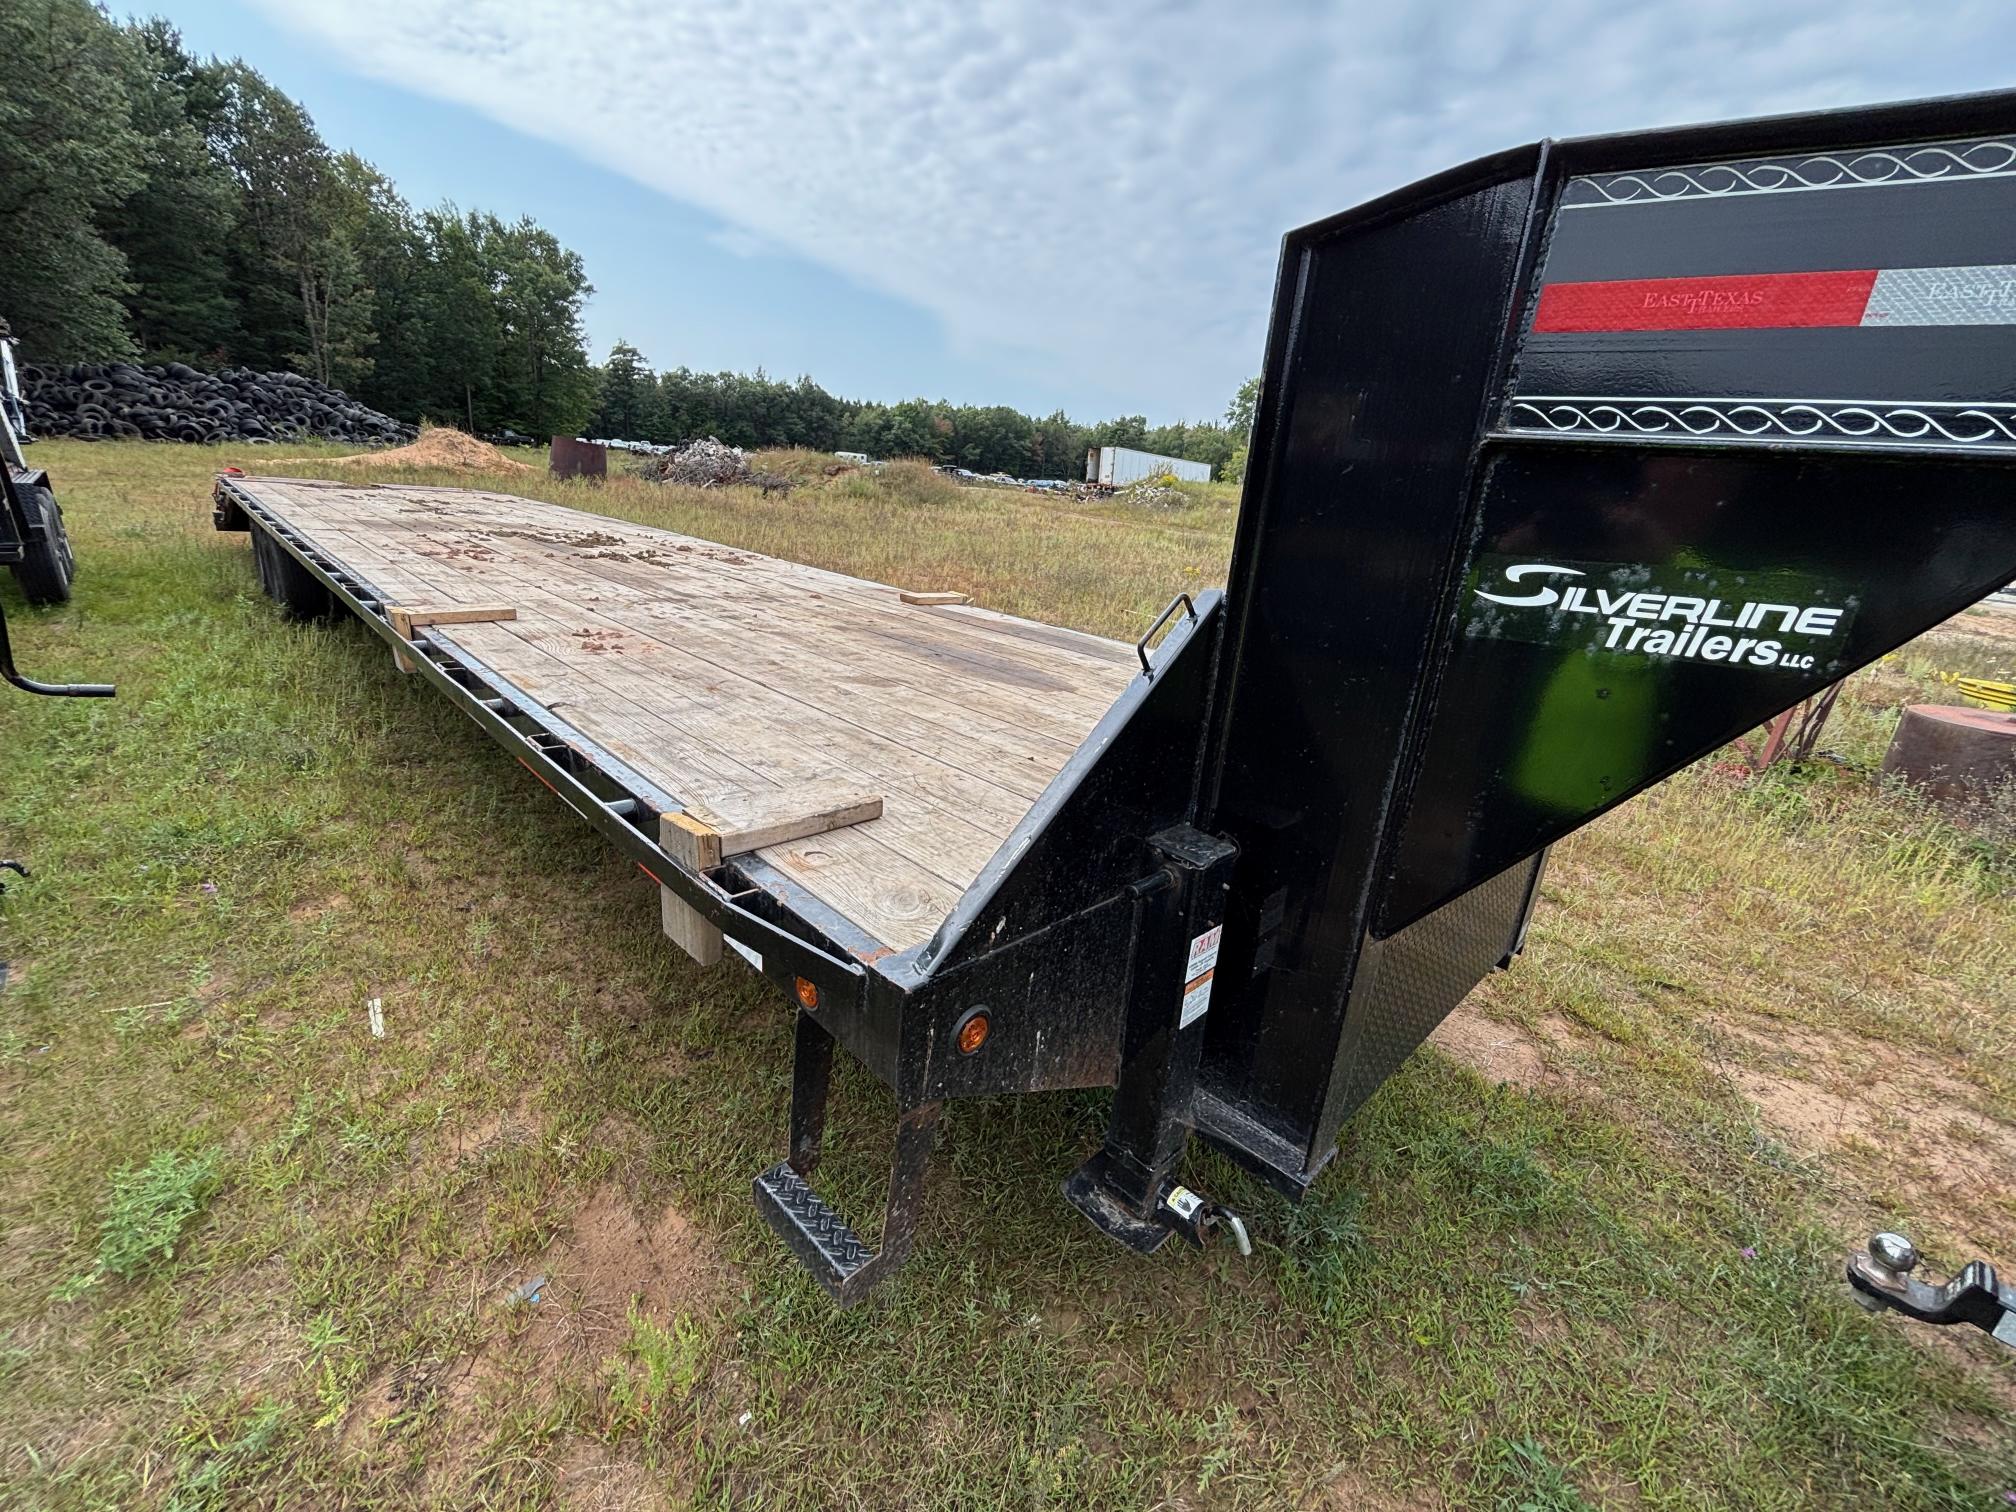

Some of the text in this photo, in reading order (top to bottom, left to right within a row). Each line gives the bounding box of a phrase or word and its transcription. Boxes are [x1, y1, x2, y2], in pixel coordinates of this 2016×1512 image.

[1642, 290, 1765, 309] EAST TEXAS
[1473, 564, 1844, 636] SILVERLINE
[1604, 616, 1815, 669] Trailers LLC
